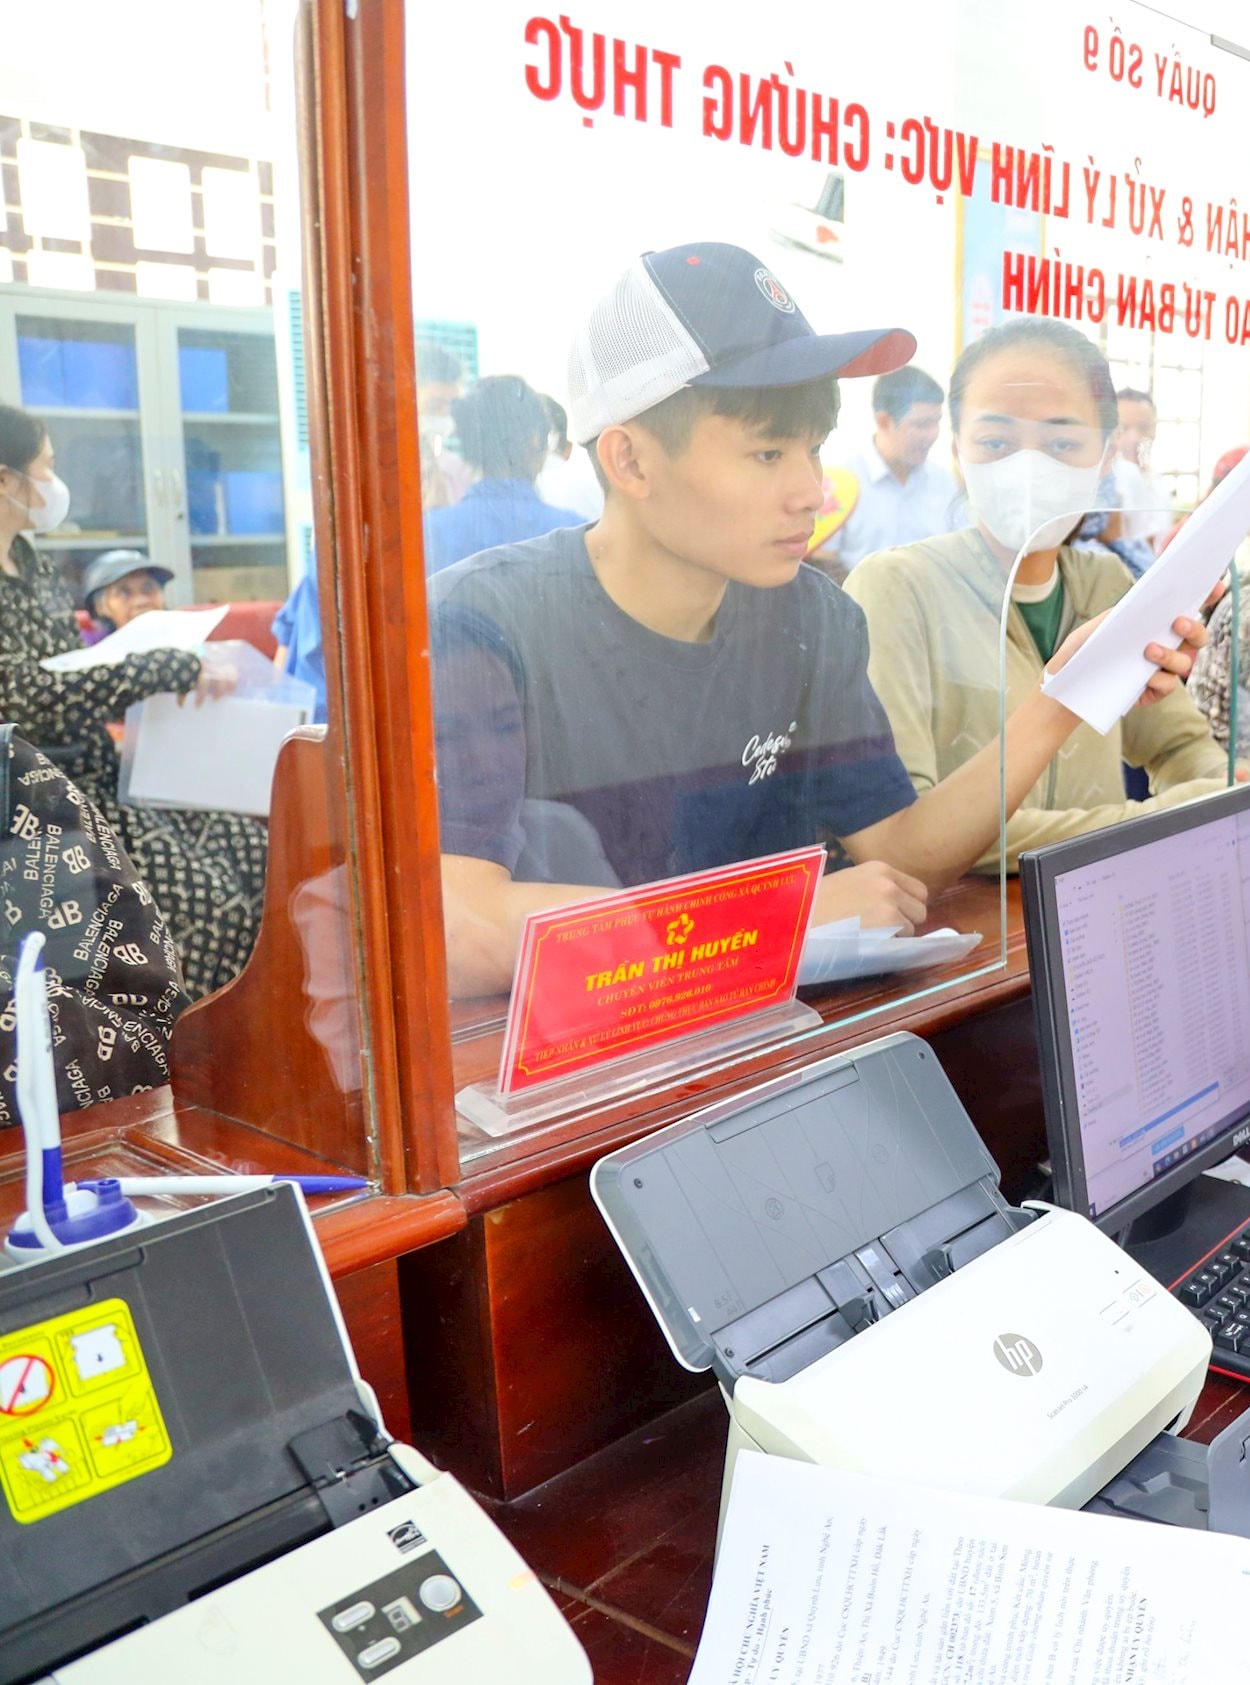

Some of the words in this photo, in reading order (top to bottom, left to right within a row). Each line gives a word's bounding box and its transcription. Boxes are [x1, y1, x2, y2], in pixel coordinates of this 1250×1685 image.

[38, 824, 62, 919] BALENCIAGA
[74, 884, 124, 962] BALENCIAGA
[84, 919, 124, 995] BALENCIAGA
[585, 960, 645, 992] TRẦN
[652, 949, 685, 973] THỊ
[690, 928, 759, 963] HUYỀN
[678, 966, 714, 982] TRUNG
[1232, 1127, 1250, 1147] DELL
[993, 1333, 1043, 1377] hp
[759, 1545, 769, 1567] NAM
